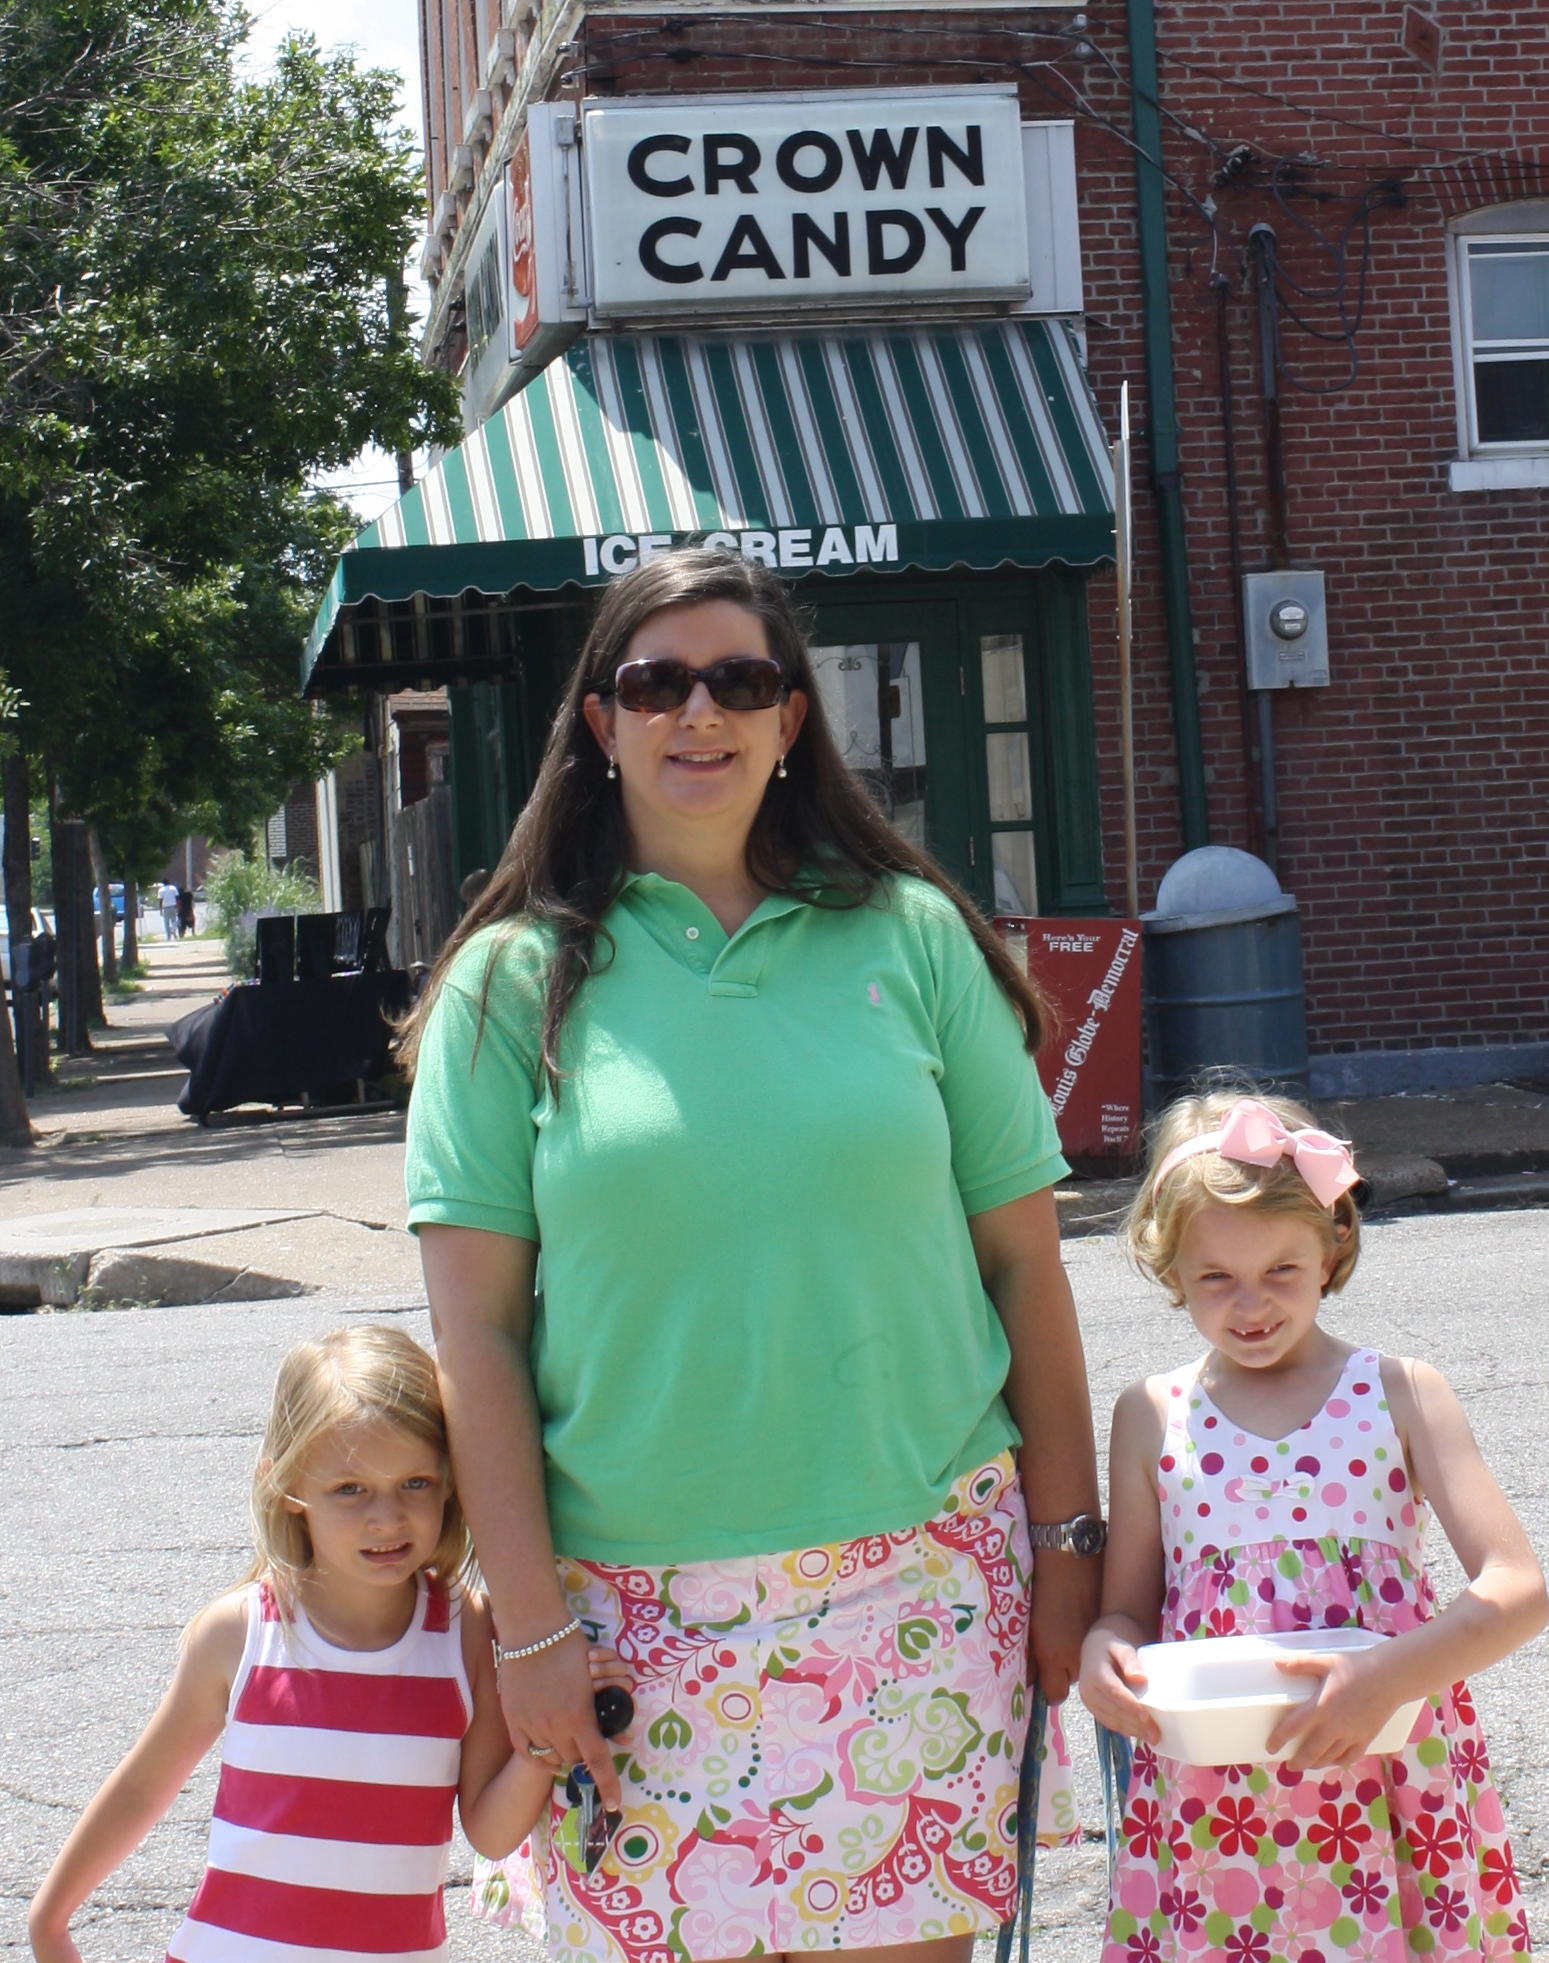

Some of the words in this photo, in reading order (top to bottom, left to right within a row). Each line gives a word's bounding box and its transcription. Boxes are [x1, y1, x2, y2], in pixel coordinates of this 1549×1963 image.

[627, 125, 986, 198] CROWN
[638, 206, 987, 284] CANDY
[583, 534, 672, 576] ICE
[1049, 941, 1094, 952] FREE
[1076, 933, 1101, 942] Your
